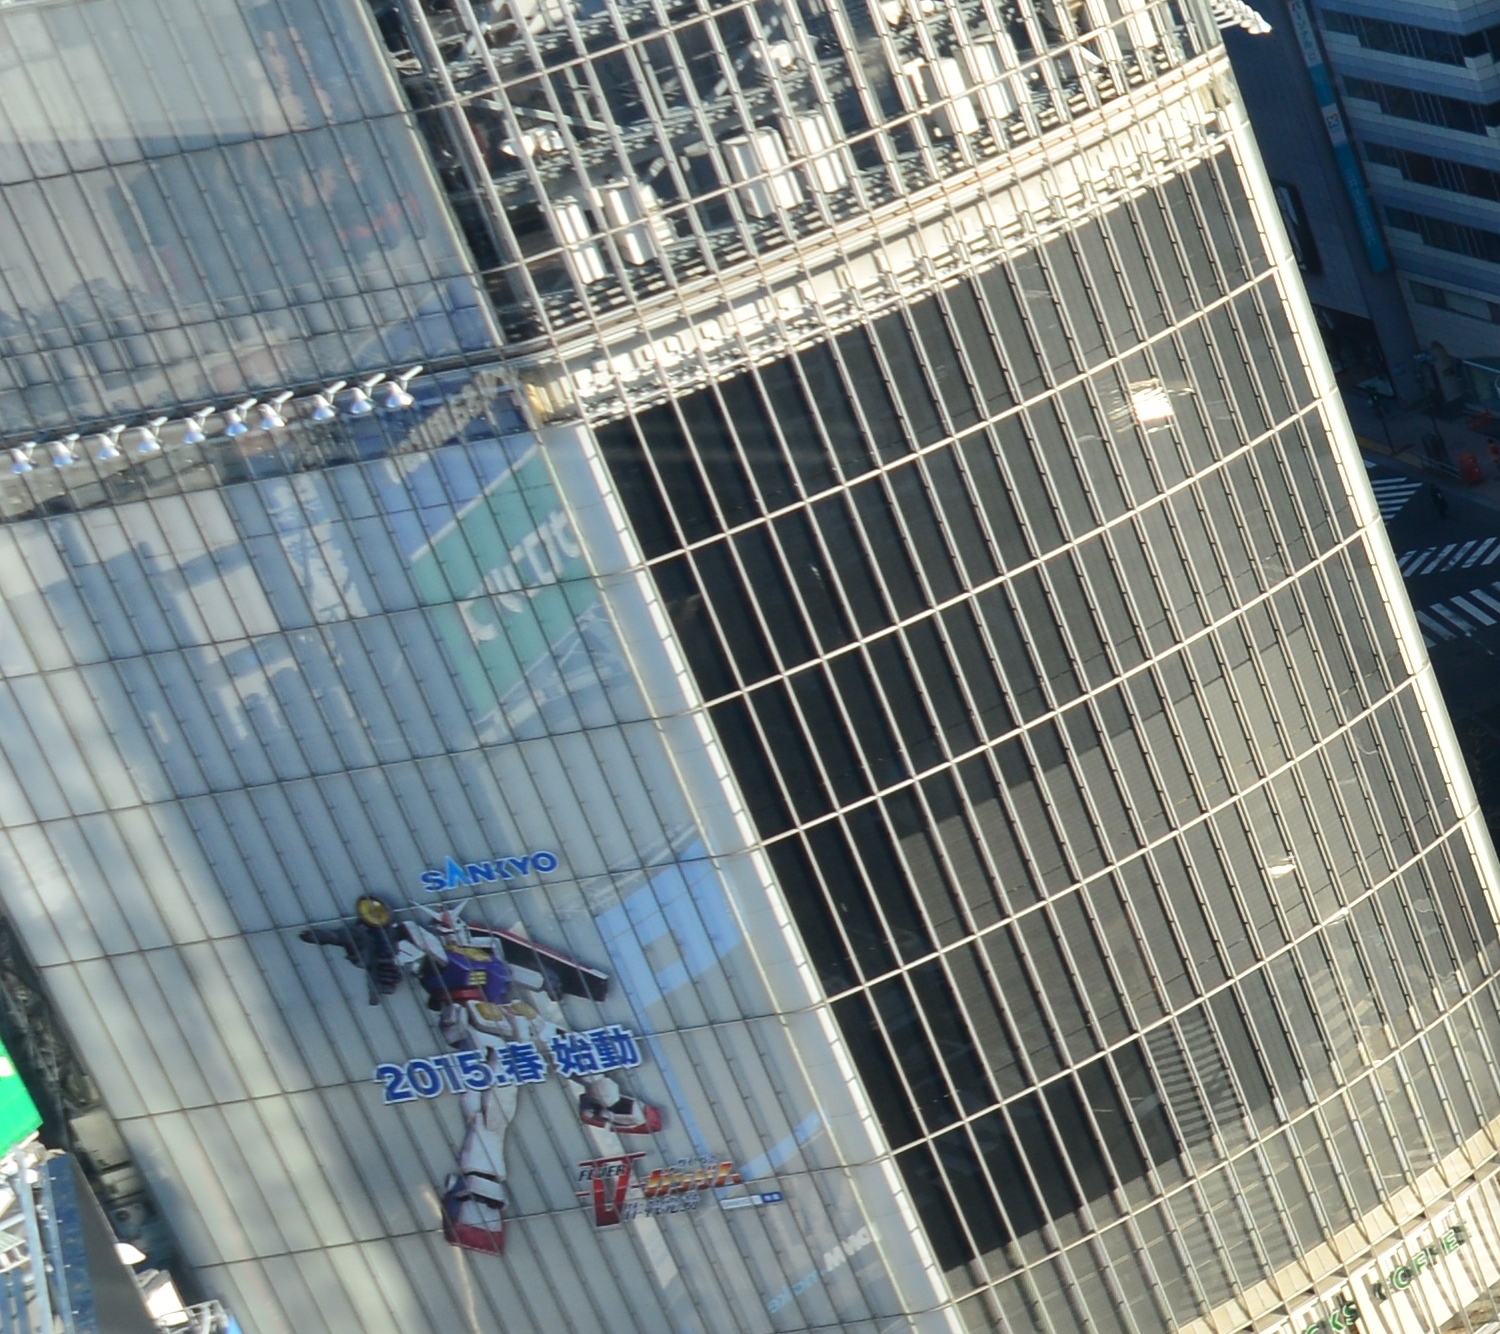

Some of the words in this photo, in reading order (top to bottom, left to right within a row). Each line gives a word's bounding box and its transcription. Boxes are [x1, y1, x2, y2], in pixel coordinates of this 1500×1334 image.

[420, 849, 558, 893] SANKYO
[375, 1040, 546, 1106] 2015.春
[551, 1023, 642, 1076] 始動
[578, 1163, 630, 1181] FEVER
